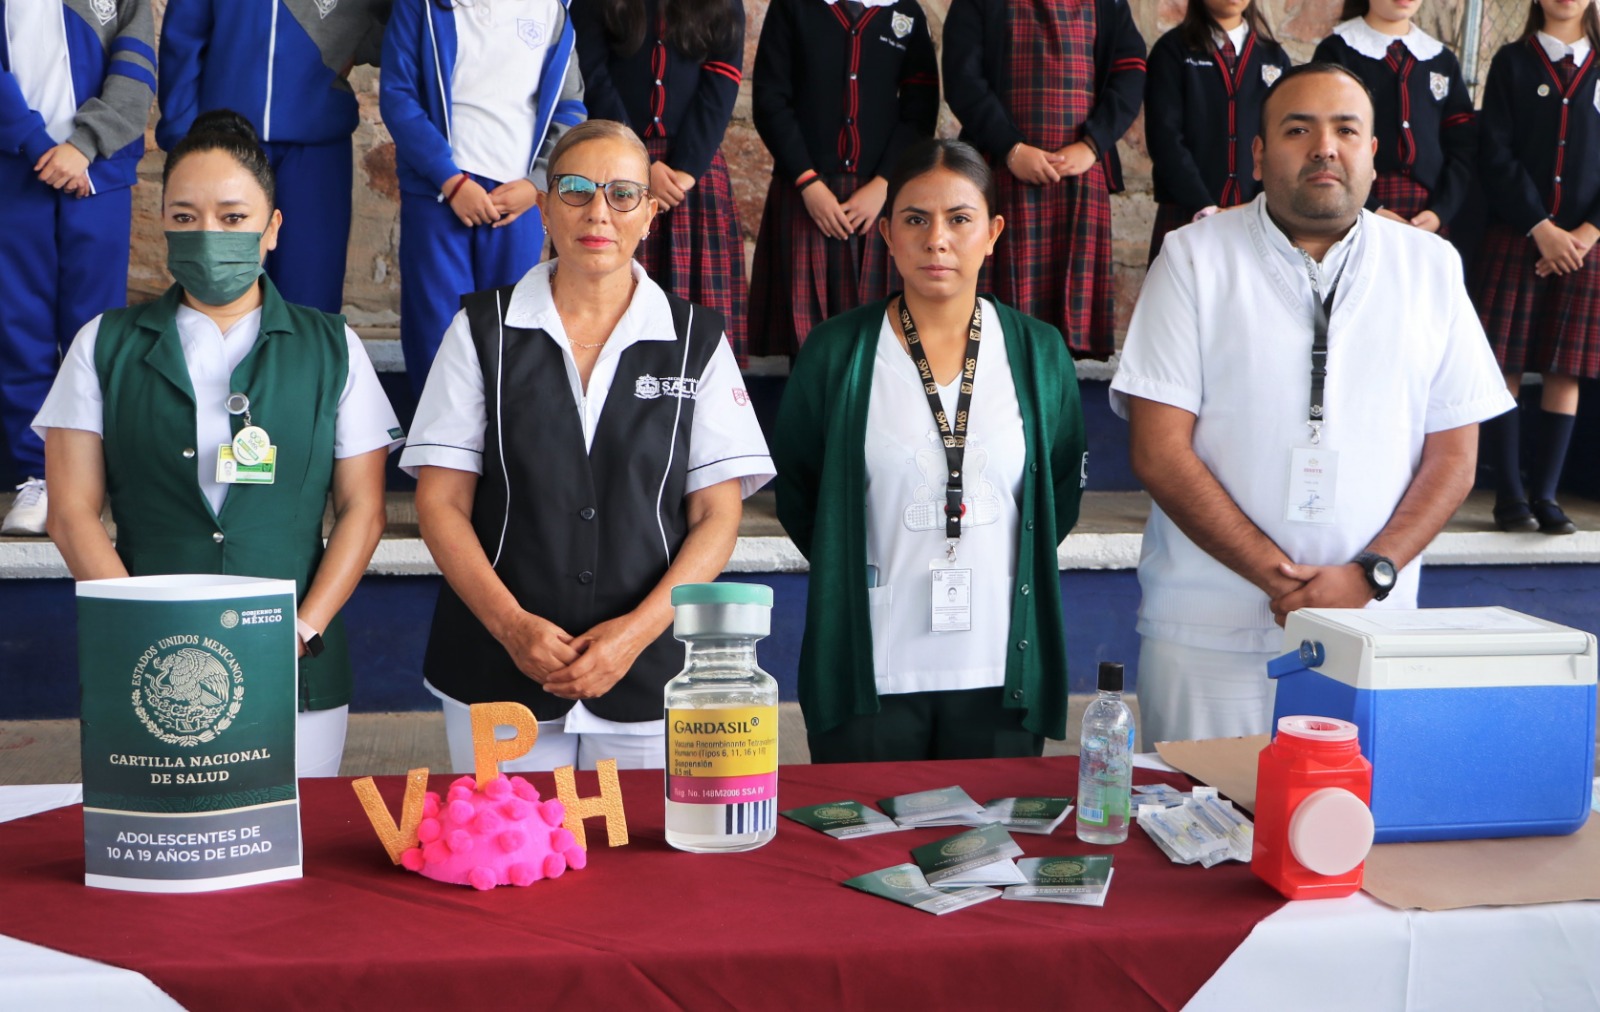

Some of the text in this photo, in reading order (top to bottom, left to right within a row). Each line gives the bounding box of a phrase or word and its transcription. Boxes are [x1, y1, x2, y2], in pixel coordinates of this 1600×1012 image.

[917, 358, 931, 379] IMSS
[963, 358, 976, 379] IMSS
[935, 411, 950, 432] IMSS
[956, 410, 967, 431] IMSS
[242, 615, 282, 625] MÉXICO
[131, 634, 244, 687] ESTADOS UNIDOS MEXICANOS
[109, 748, 271, 768] CARTILLA NACIONAL
[150, 770, 230, 784] DE SALUD
[741, 787, 757, 795] SSA
[116, 826, 261, 845] ADOLESCENTES DE
[107, 841, 273, 862] 10 A 19 AÑOS DE EDAD
